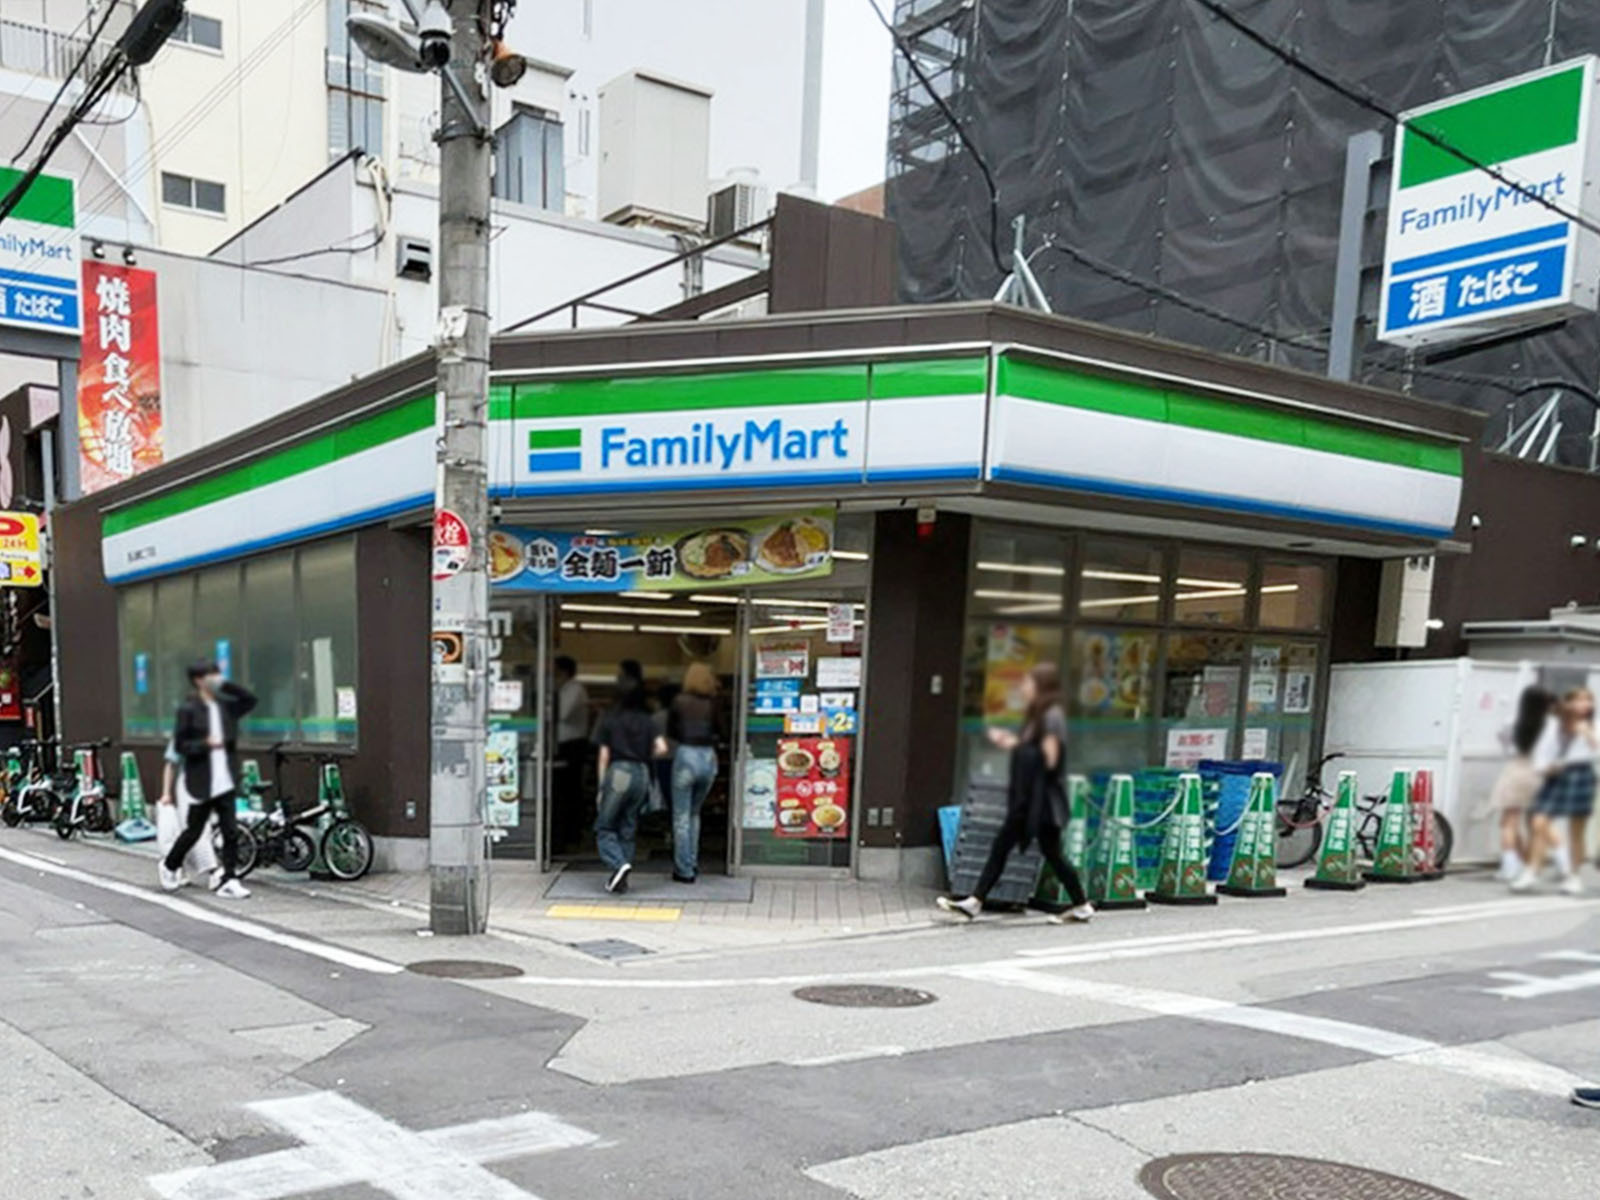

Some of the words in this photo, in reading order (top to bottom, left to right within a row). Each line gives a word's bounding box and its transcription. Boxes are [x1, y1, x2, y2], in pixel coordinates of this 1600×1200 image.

[1400, 172, 1566, 235] FamilyMart
[14, 290, 64, 321] たばこ
[1408, 276, 1448, 321] 酒
[1457, 261, 1539, 308] たばこ
[601, 418, 849, 470] FamilyMart
[564, 547, 674, 579] 全麺一新
